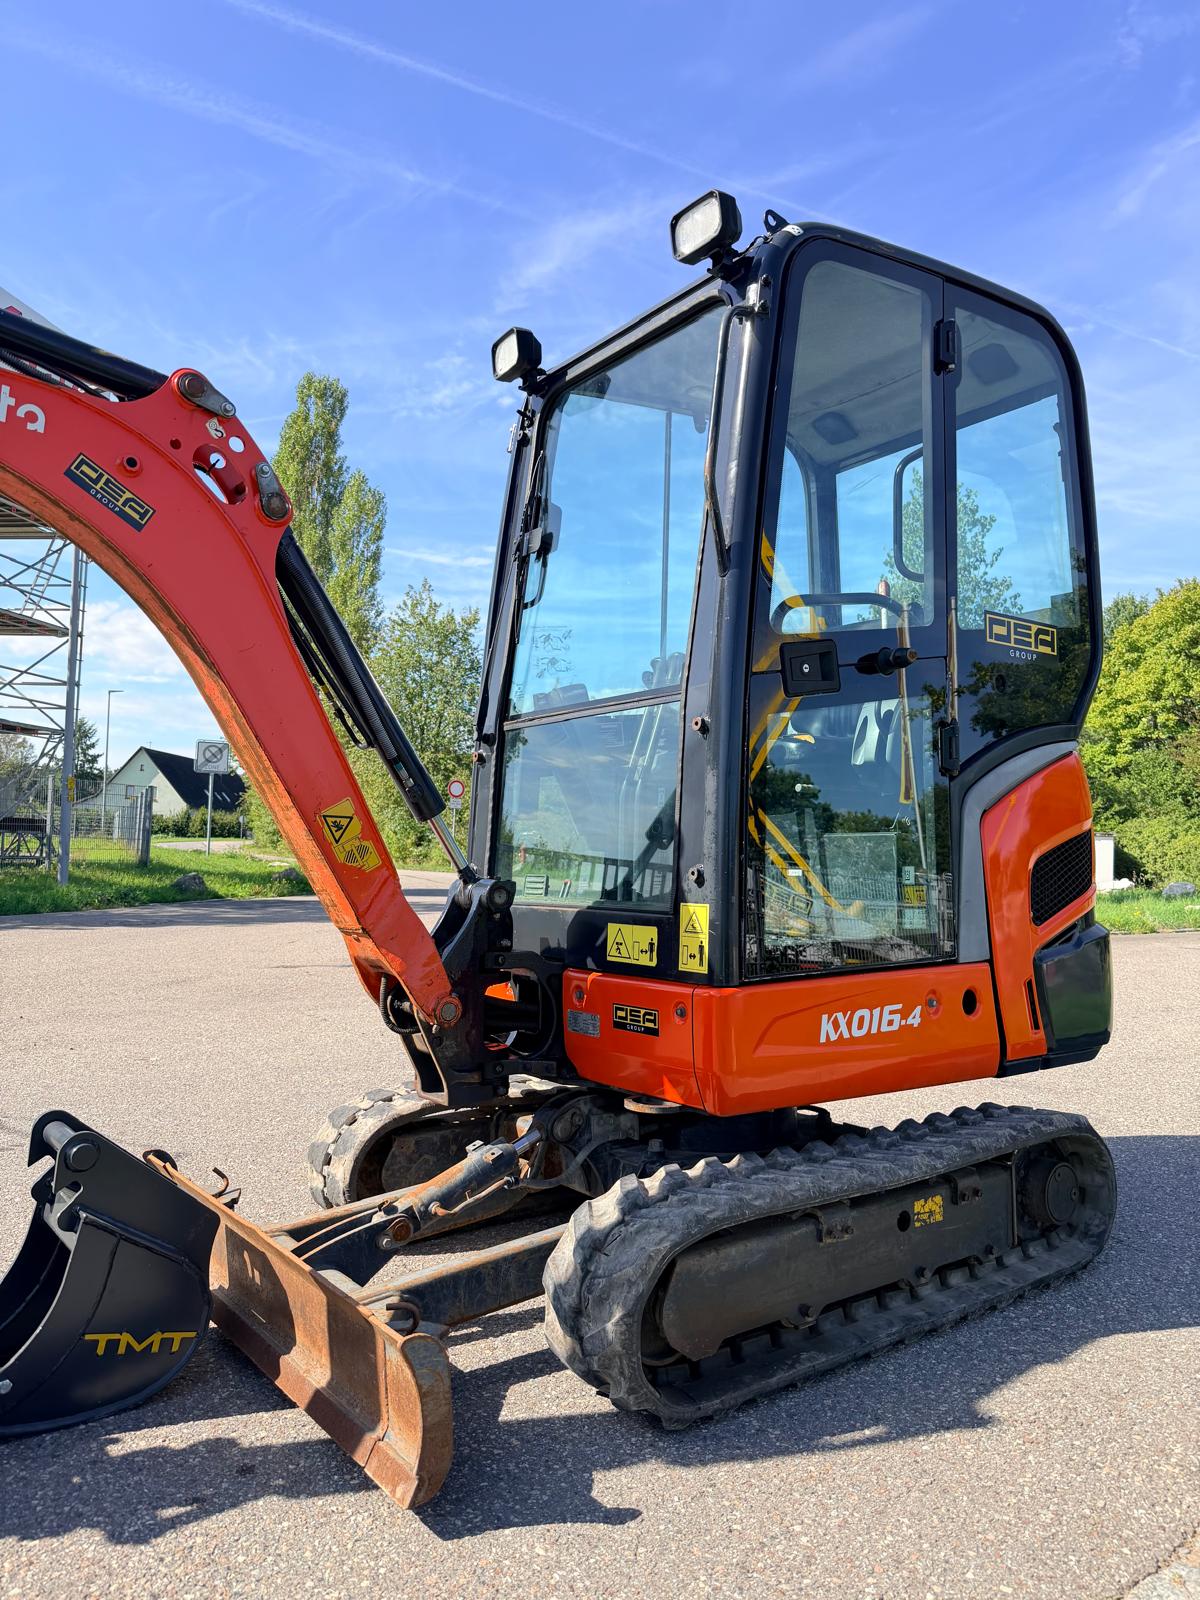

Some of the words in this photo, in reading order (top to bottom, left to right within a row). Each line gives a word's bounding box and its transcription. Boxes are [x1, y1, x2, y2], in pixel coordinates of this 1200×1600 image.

[90, 488, 120, 512] GROUP
[1009, 649, 1037, 661] GROUP
[819, 1003, 922, 1043] KX016-4
[84, 1331, 198, 1356] TMT
